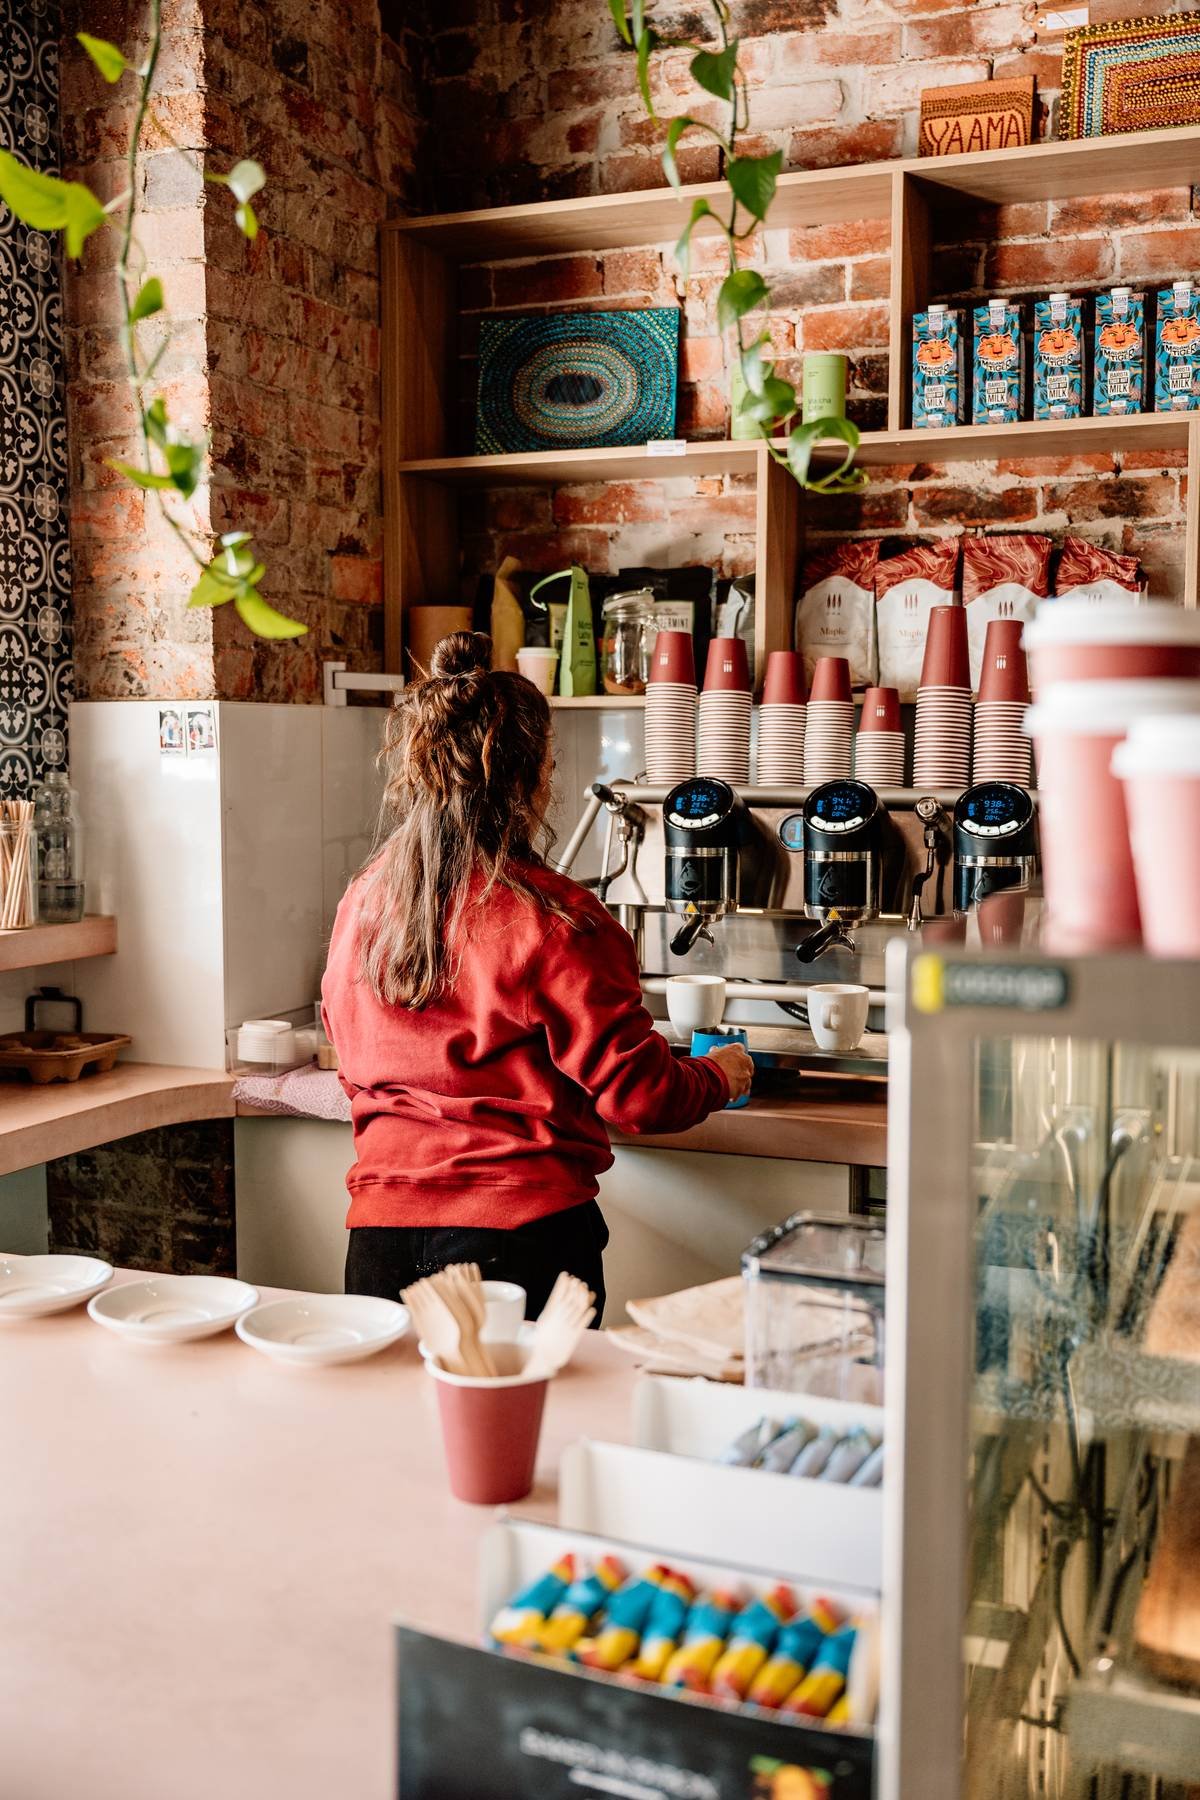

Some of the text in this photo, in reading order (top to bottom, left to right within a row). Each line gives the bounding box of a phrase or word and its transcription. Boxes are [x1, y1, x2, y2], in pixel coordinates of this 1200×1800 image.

[928, 113, 1021, 156] YAAMA
[1173, 342, 1197, 355] TIGER
[1111, 348, 1135, 361] TIGER
[1050, 353, 1073, 366] TIGER
[1109, 384, 1128, 393] MILK
[1171, 380, 1190, 389] MILK
[987, 394, 1005, 402] MILK
[1049, 390, 1067, 398] MILK
[927, 399, 943, 407] MILK
